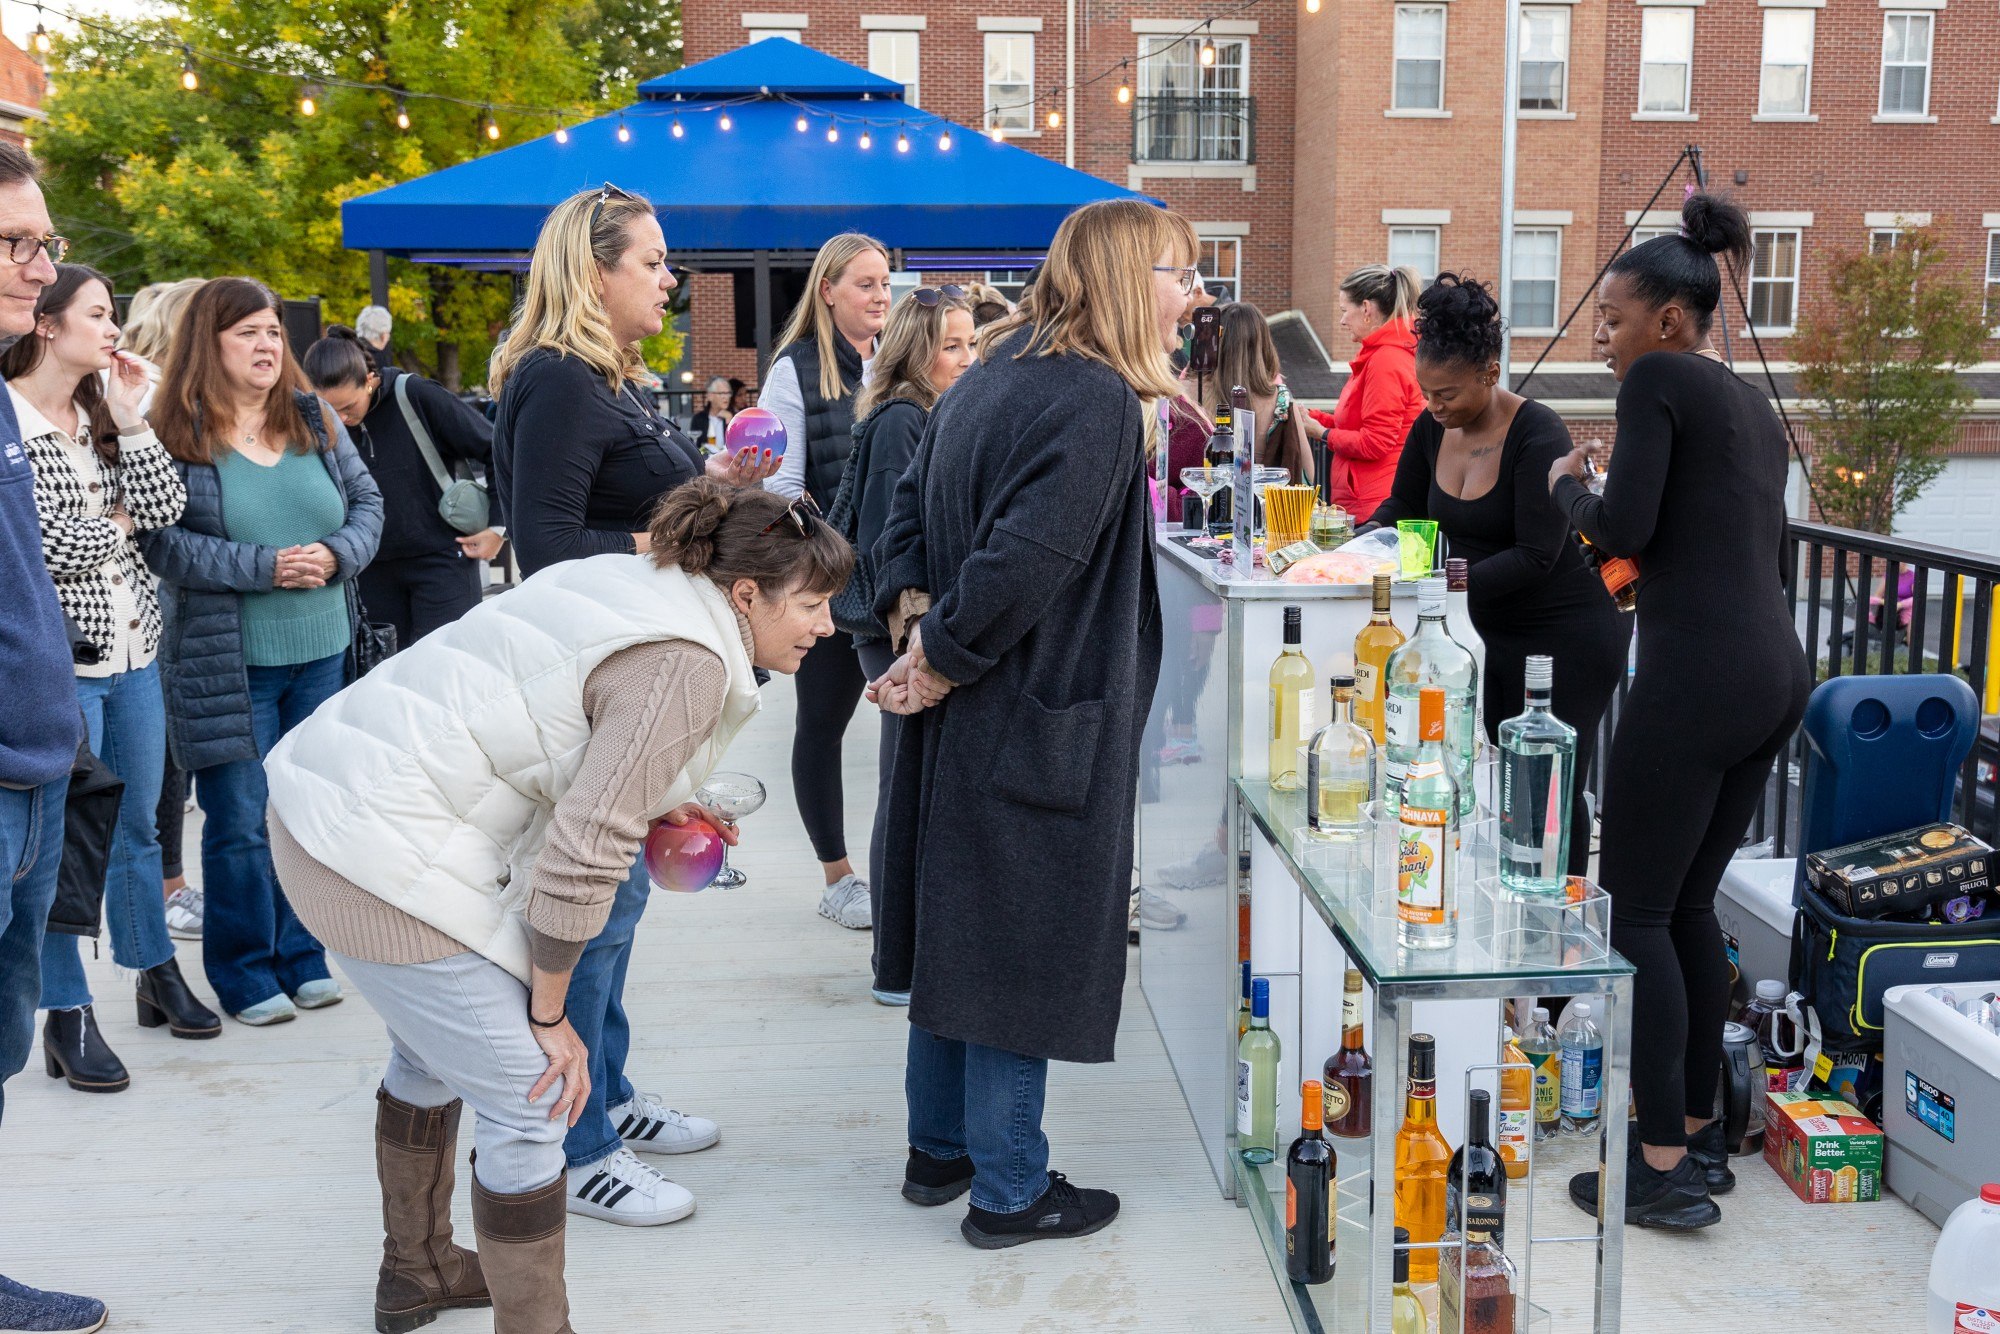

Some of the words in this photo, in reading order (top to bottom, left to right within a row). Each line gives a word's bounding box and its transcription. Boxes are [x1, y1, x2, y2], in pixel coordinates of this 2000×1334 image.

[1503, 761, 1512, 813] AMSTERDAM
[1399, 855, 1428, 877] hranj
[1840, 1052, 1866, 1068] MOON
[1535, 1087, 1553, 1096] ONIC
[1906, 1075, 1918, 1102] 5
[1500, 1123, 1521, 1132] Juice
[1815, 1140, 1840, 1149] Drink
[1814, 1149, 1845, 1157] Better.
[1466, 1217, 1500, 1226] ISARONNO
[1966, 1316, 1996, 1328] DISTILLED
[1971, 1321, 1991, 1331] WATER
